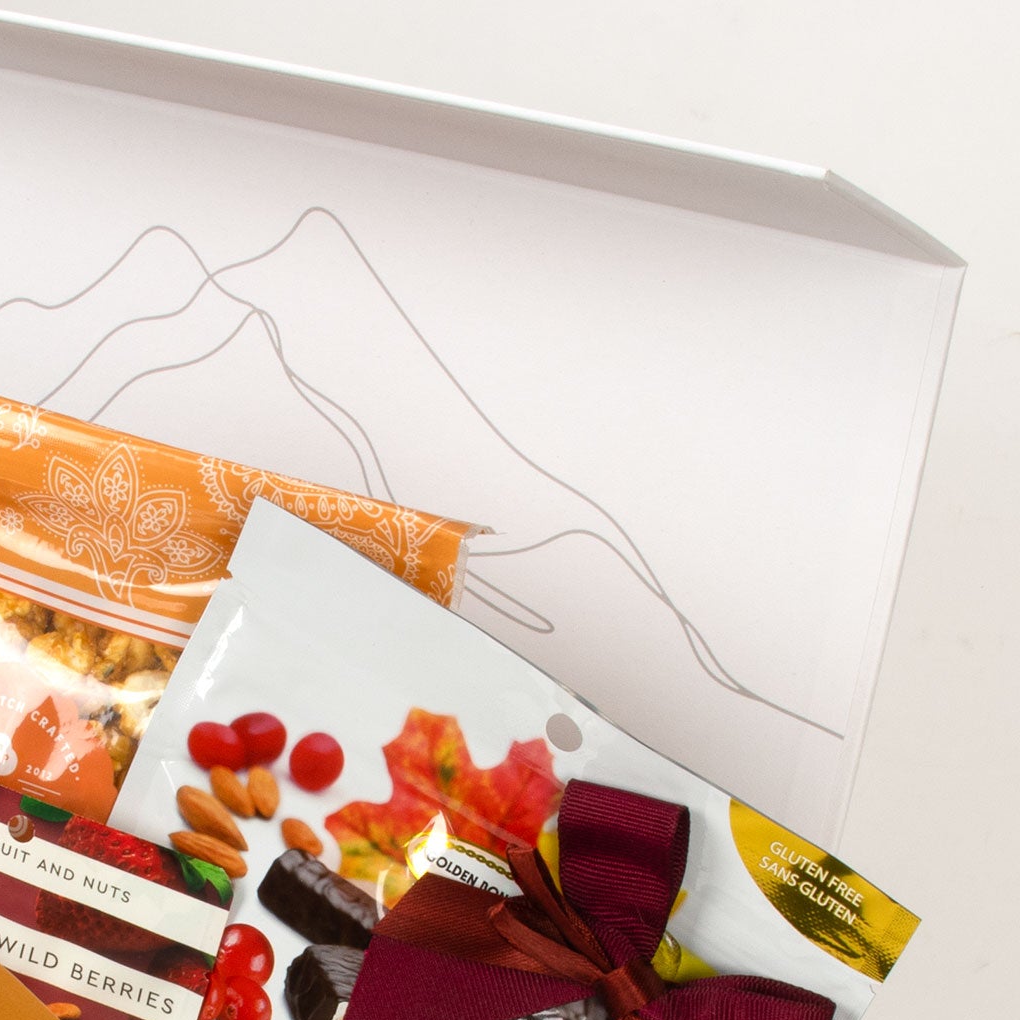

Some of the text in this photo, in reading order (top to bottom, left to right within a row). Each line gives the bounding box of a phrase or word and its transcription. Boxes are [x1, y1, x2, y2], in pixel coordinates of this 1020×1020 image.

[37, 859, 76, 882] AND
[83, 875, 132, 904] NUTS
[758, 856, 857, 925] SANS GLUTEN
[770, 841, 865, 908] GLUTEN FREE
[70, 962, 176, 1015] BERRIES
